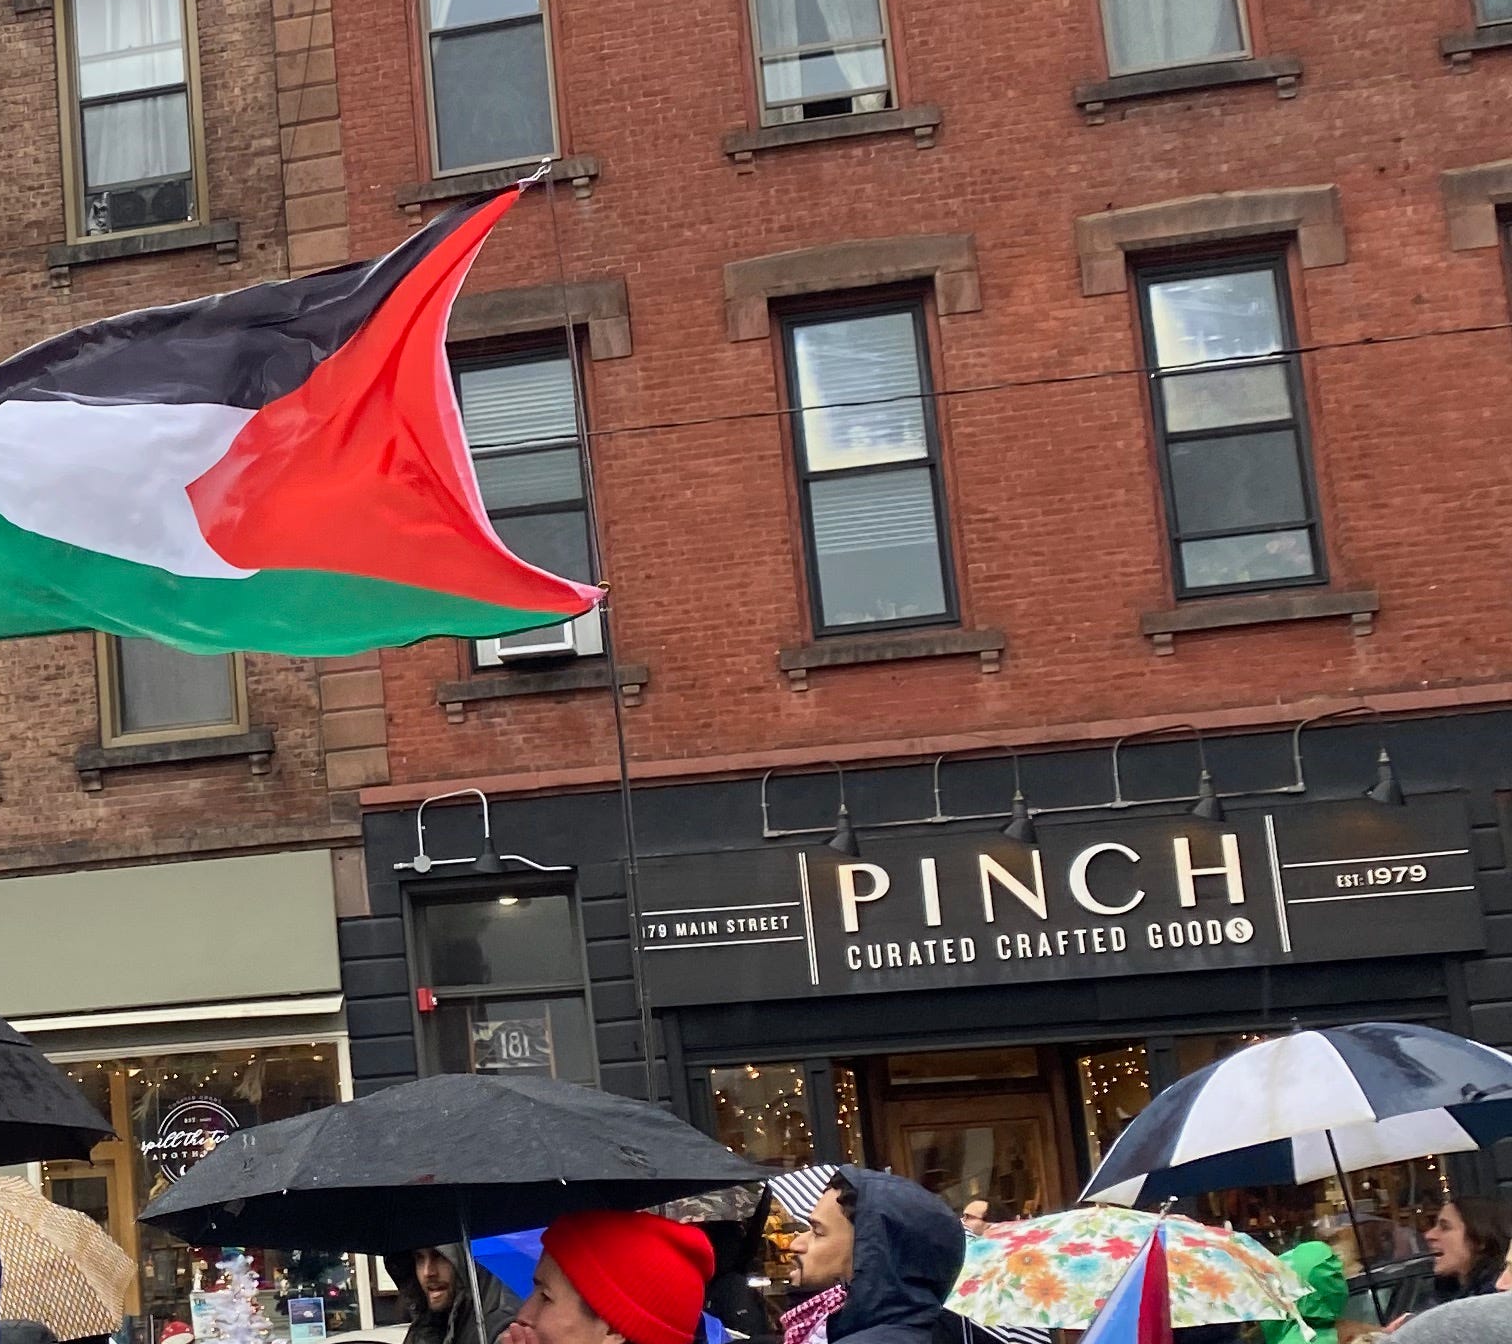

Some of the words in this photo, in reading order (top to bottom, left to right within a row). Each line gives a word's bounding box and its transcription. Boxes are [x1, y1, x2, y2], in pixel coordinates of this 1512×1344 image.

[838, 833, 1245, 933] PINCH
[1366, 864, 1427, 885] 1979
[675, 920, 718, 937] MAIN
[726, 915, 790, 934] STREET
[847, 937, 976, 970] CURATED
[996, 926, 1127, 960] CRAFTED
[1148, 918, 1255, 949] GOODS
[500, 1031, 530, 1059] 181
